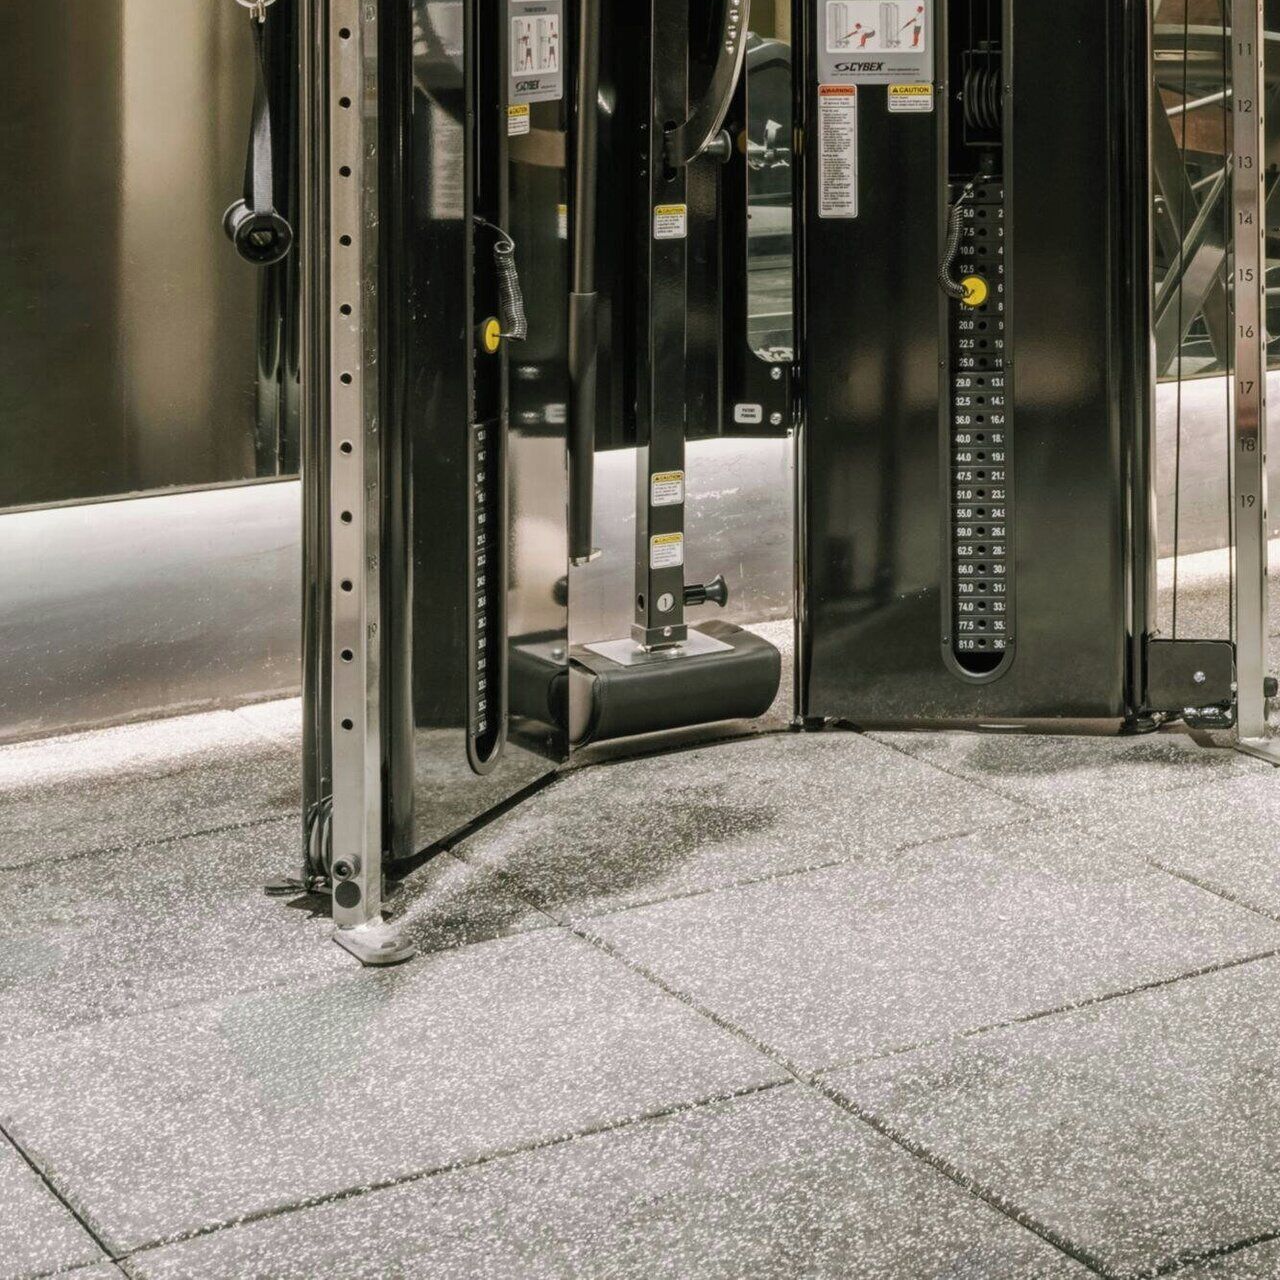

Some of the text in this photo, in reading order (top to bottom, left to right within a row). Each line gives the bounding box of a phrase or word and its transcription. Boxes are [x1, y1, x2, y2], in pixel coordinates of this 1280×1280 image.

[1238, 43, 1252, 56] 11
[849, 62, 884, 72] CYBEX
[1238, 99, 1252, 112] 12
[1238, 156, 1253, 168] 13
[963, 209, 1004, 218] 5.0 2
[1238, 213, 1253, 225] 14
[963, 228, 1004, 236] 7.5 3
[960, 246, 1004, 255] 10.0 4
[960, 264, 1004, 273] 12.5 5
[1238, 270, 1254, 282] 15
[998, 284, 1003, 292] 6
[998, 302, 1004, 311] 8
[958, 321, 1004, 330] 20.0 9
[1238, 326, 1254, 338] 16
[959, 339, 1004, 348] 22.5 10
[959, 358, 1003, 367] 25.0 11
[956, 378, 971, 387] 29.0
[1239, 382, 1254, 394] 17
[955, 397, 971, 406] 32.5
[955, 416, 971, 424] 36.0
[955, 434, 971, 443] 40.0
[1240, 438, 1256, 452] 18
[956, 452, 971, 462] 44.0
[956, 472, 972, 481] 47.5
[956, 490, 972, 499] 51.0
[1240, 495, 1256, 508] 19
[956, 509, 972, 518] 55.0
[956, 528, 972, 536] 59.0
[957, 546, 973, 556] 62.5
[958, 565, 973, 574] 66.0
[958, 584, 974, 592] 70.0
[958, 602, 974, 612] 74.0
[958, 621, 974, 630] 77.5
[958, 640, 974, 649] 81.0
